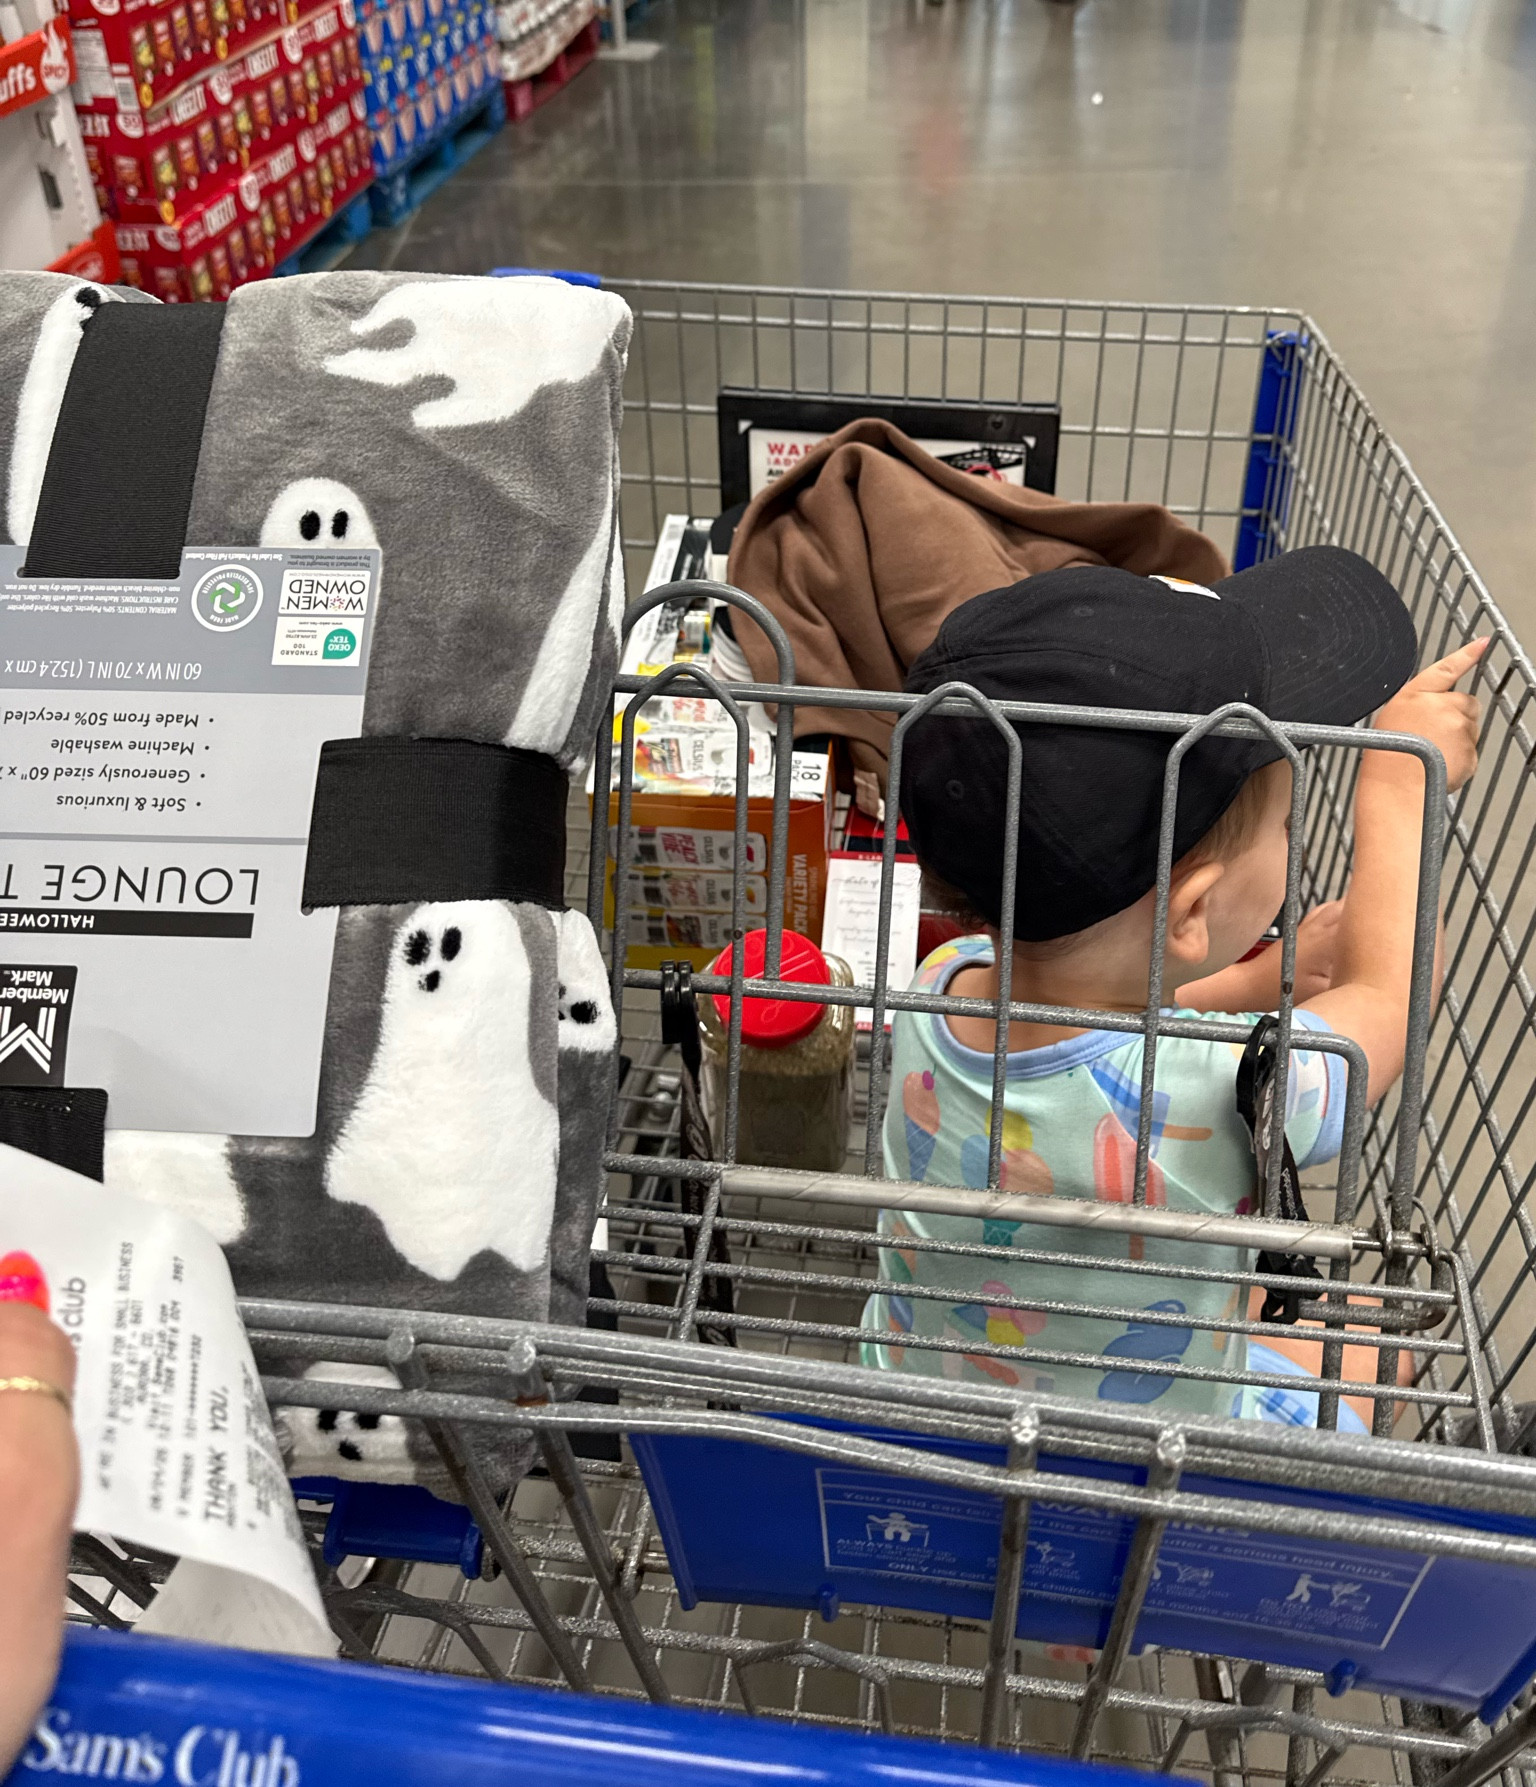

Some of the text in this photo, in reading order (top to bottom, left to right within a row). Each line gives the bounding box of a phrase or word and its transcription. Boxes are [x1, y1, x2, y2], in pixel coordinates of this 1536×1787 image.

[0, 61, 38, 102] uffs
[206, 552, 218, 560] Fiber
[306, 559, 330, 568] brought
[336, 560, 358, 568] product
[51, 583, 60, 591] dry
[289, 580, 366, 594] OWNED
[7, 603, 34, 612] polyester
[120, 595, 162, 603] INSTRUCTIONS:
[34, 604, 60, 613] Recycled
[148, 606, 178, 614] MATERIAL
[328, 643, 352, 652] OEKO
[4, 658, 202, 680] 60 IN W x 70 IN L (152.4 cm x
[4, 707, 200, 728] Made from 50% recycled
[50, 739, 195, 756] Machine washable
[692, 740, 705, 772] CELSIUS
[8, 764, 190, 784] Generously sized 60" x
[801, 763, 822, 782] 18
[56, 796, 187, 812] Soft & luxurious
[0, 864, 260, 906] LOUNGE T
[792, 854, 808, 934] VARIETY PACK
[0, 913, 95, 929] HALLOWEE
[0, 986, 70, 1004] Member
[116, 1241, 134, 1292] BUSINESS
[113, 1299, 130, 1330] SMALL
[110, 1334, 126, 1356] FOR
[105, 1362, 124, 1419] BUSINESS
[204, 1386, 230, 1521] THANK YOU,
[886, 1497, 927, 1509] child
[1291, 1554, 1336, 1570] head
[836, 1538, 893, 1550] ALWAYS
[888, 1561, 928, 1573] ONLY
[173, 1723, 301, 1787] Club
